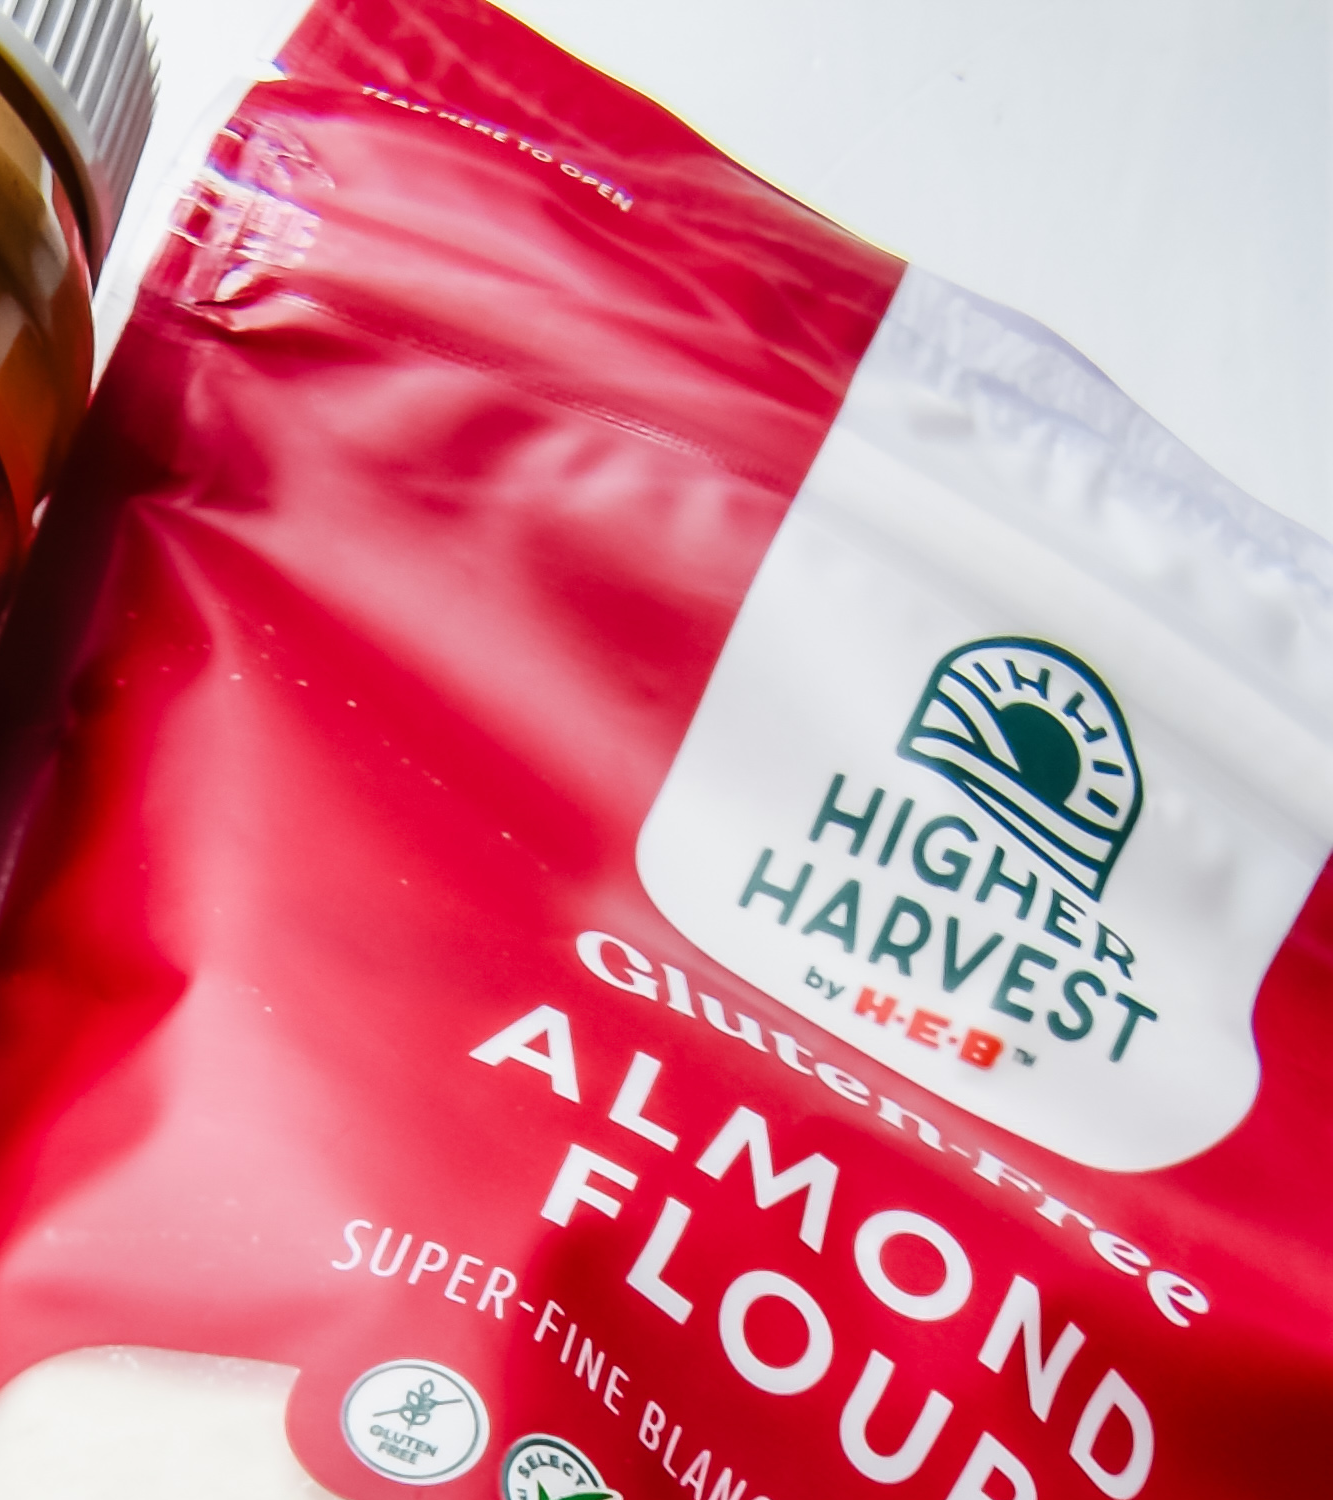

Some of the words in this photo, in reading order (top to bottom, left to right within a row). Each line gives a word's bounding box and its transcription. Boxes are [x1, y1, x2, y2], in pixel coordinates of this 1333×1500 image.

[436, 109, 511, 144] HERE
[514, 137, 555, 165] TO
[559, 159, 634, 214] OPEN
[807, 772, 1138, 982] HIGHER
[737, 847, 1160, 1065] HARVEST
[803, 965, 845, 1001] by
[573, 928, 1212, 1330] Gluten-Free
[330, 1217, 632, 1418] SUPER-FINE
[367, 1422, 439, 1461] GLUTEN
[377, 1440, 421, 1466] FREE
